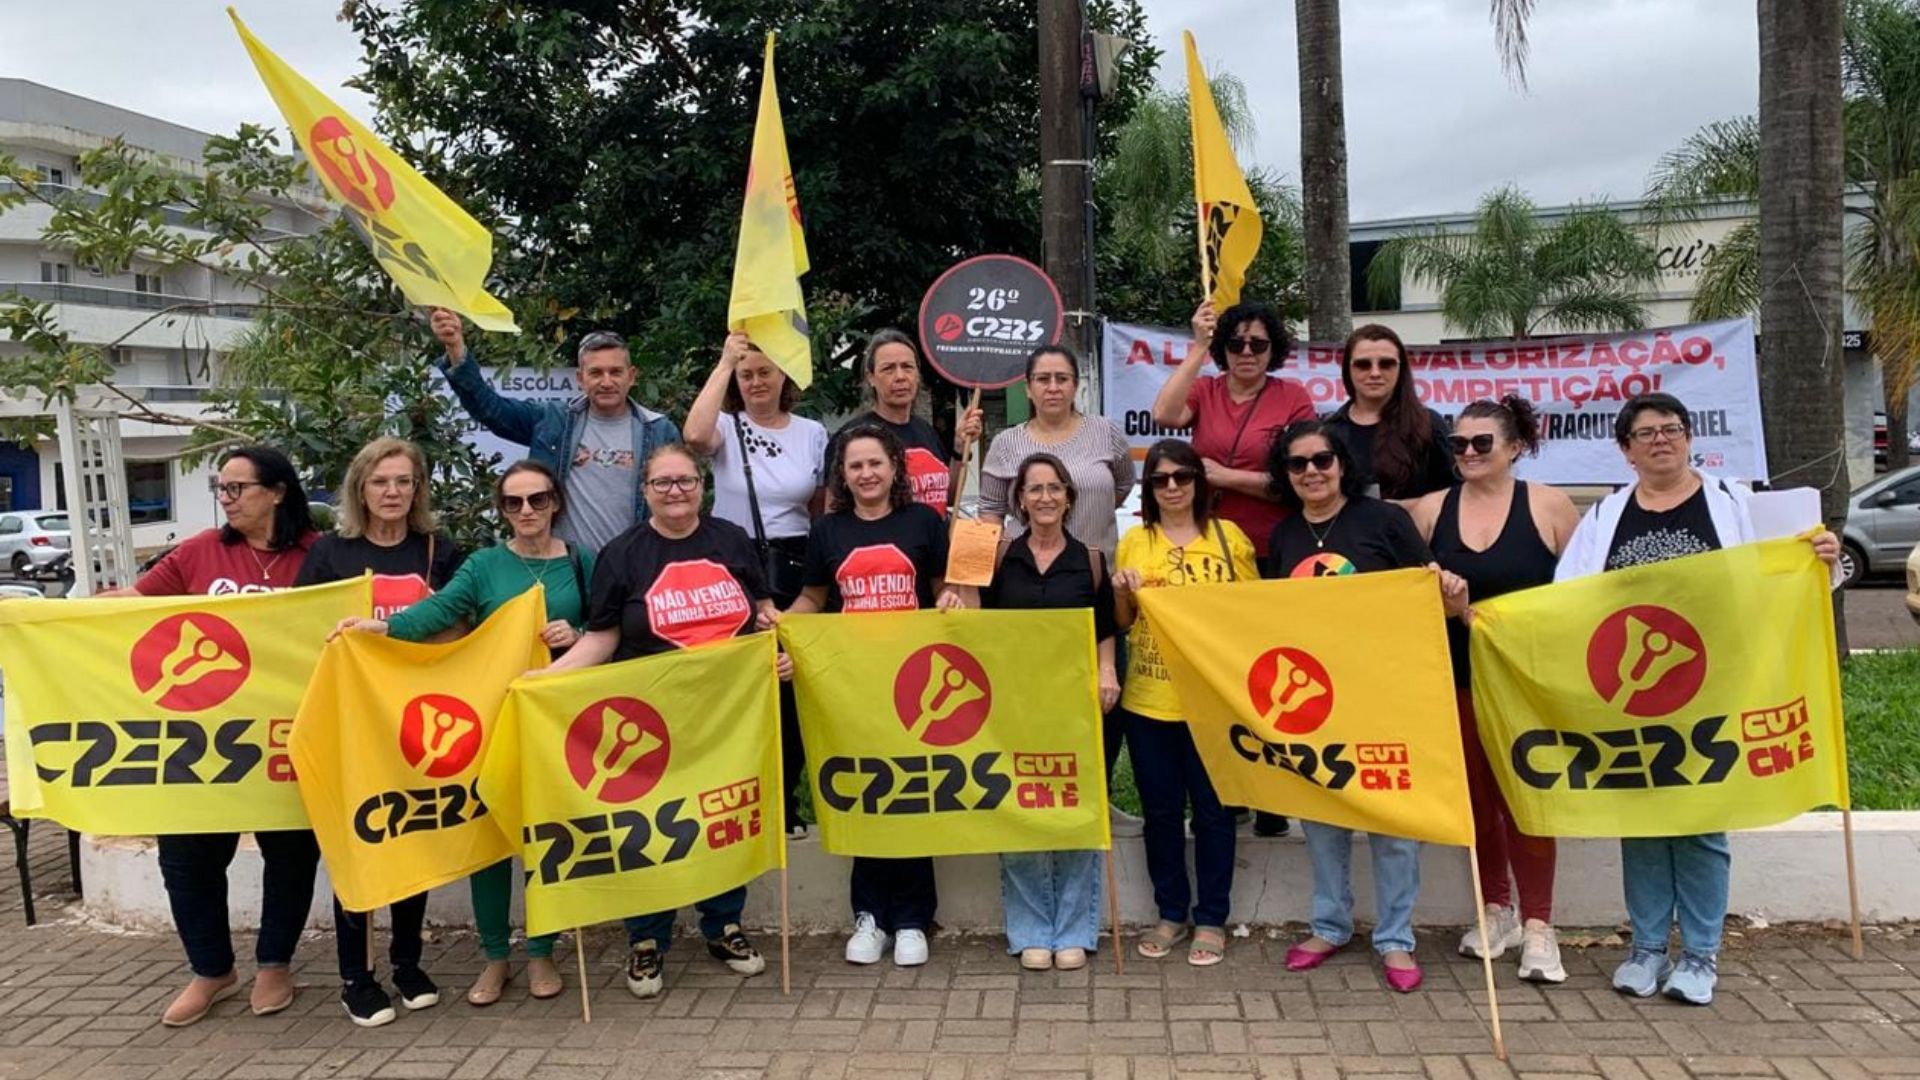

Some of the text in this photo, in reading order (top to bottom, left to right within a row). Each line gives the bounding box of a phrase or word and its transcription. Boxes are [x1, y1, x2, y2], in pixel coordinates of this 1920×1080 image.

[966, 316, 1045, 341] CPERS
[1126, 340, 1155, 365] A
[501, 377, 573, 391] ESCOLA
[1412, 369, 1662, 409] OMPETIÇÃO!
[1688, 410, 1732, 437] RIEL
[653, 589, 687, 611] NÃO
[657, 599, 746, 627] A MINHA ESCOLA
[1743, 699, 1805, 739] CUT
[29, 719, 262, 787] CPERS
[1016, 755, 1075, 775] CUT
[1228, 723, 1355, 790] CPERS
[1358, 746, 1406, 763] CUT
[1511, 715, 1739, 790] CPERS
[701, 780, 759, 817] CUT
[818, 752, 1012, 814] CPERS
[523, 797, 699, 888] PERS
